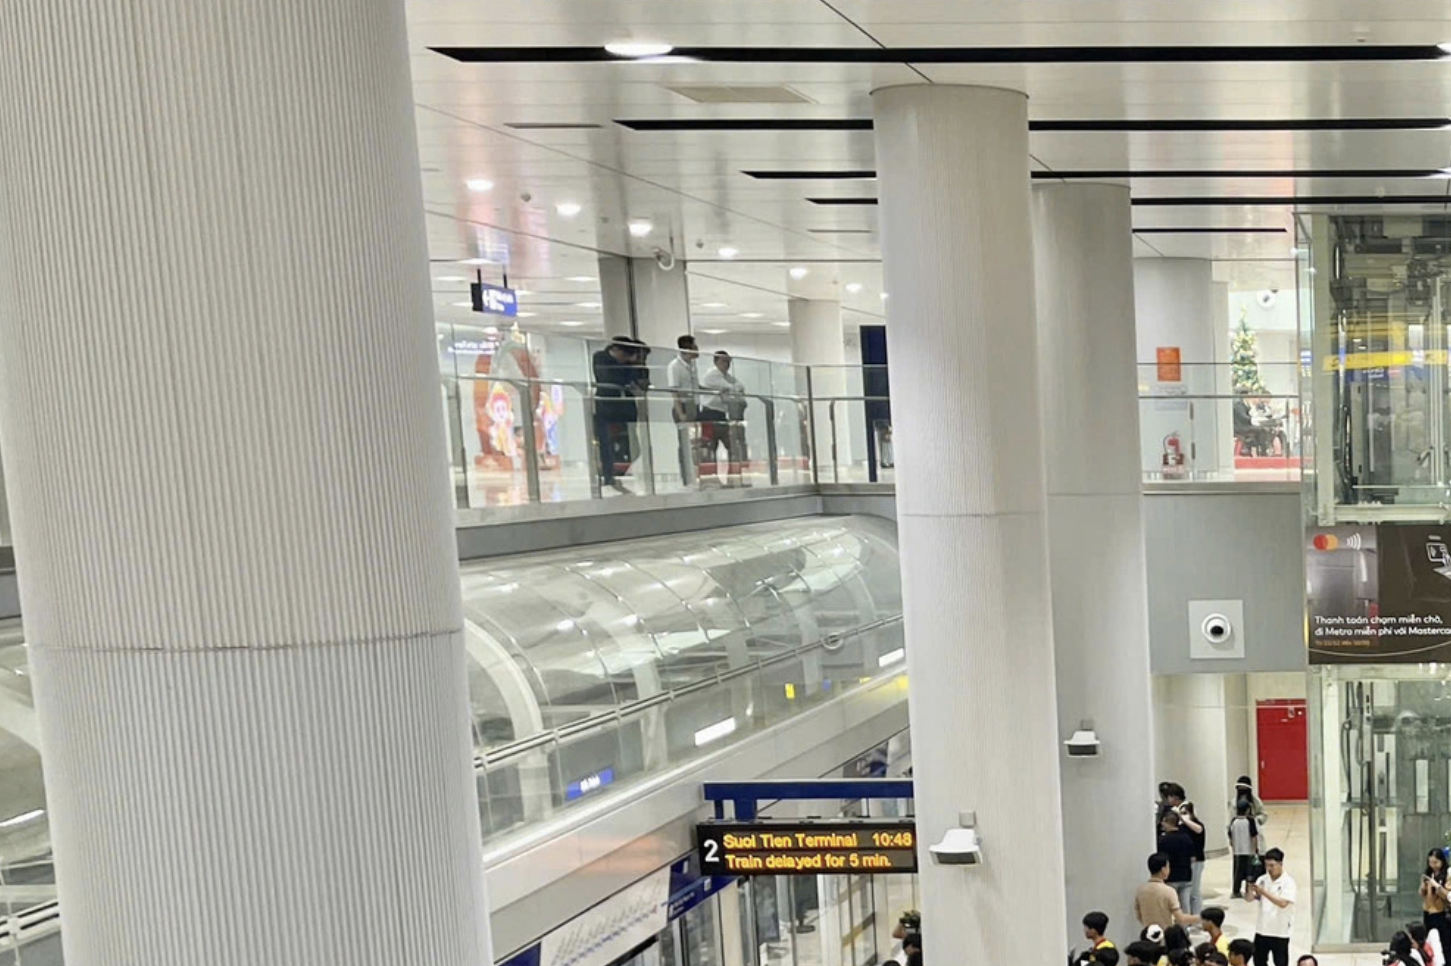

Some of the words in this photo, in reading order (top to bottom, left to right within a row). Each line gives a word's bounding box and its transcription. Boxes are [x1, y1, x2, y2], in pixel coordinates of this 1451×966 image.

[1314, 615, 1345, 625] Thanh
[1346, 615, 1369, 625] toán
[1370, 614, 1397, 626] chạm
[1324, 627, 1353, 636] Metro
[1377, 626, 1392, 638] phí
[723, 833, 757, 849] Suoi
[760, 833, 792, 848] Tien
[795, 832, 858, 849] Terminal
[872, 832, 913, 847] 10:48
[703, 839, 720, 862] 2
[724, 854, 763, 869] Train
[765, 854, 821, 870] delayed
[824, 854, 846, 868] for
[850, 853, 859, 868] 5
[862, 854, 892, 868] min.
